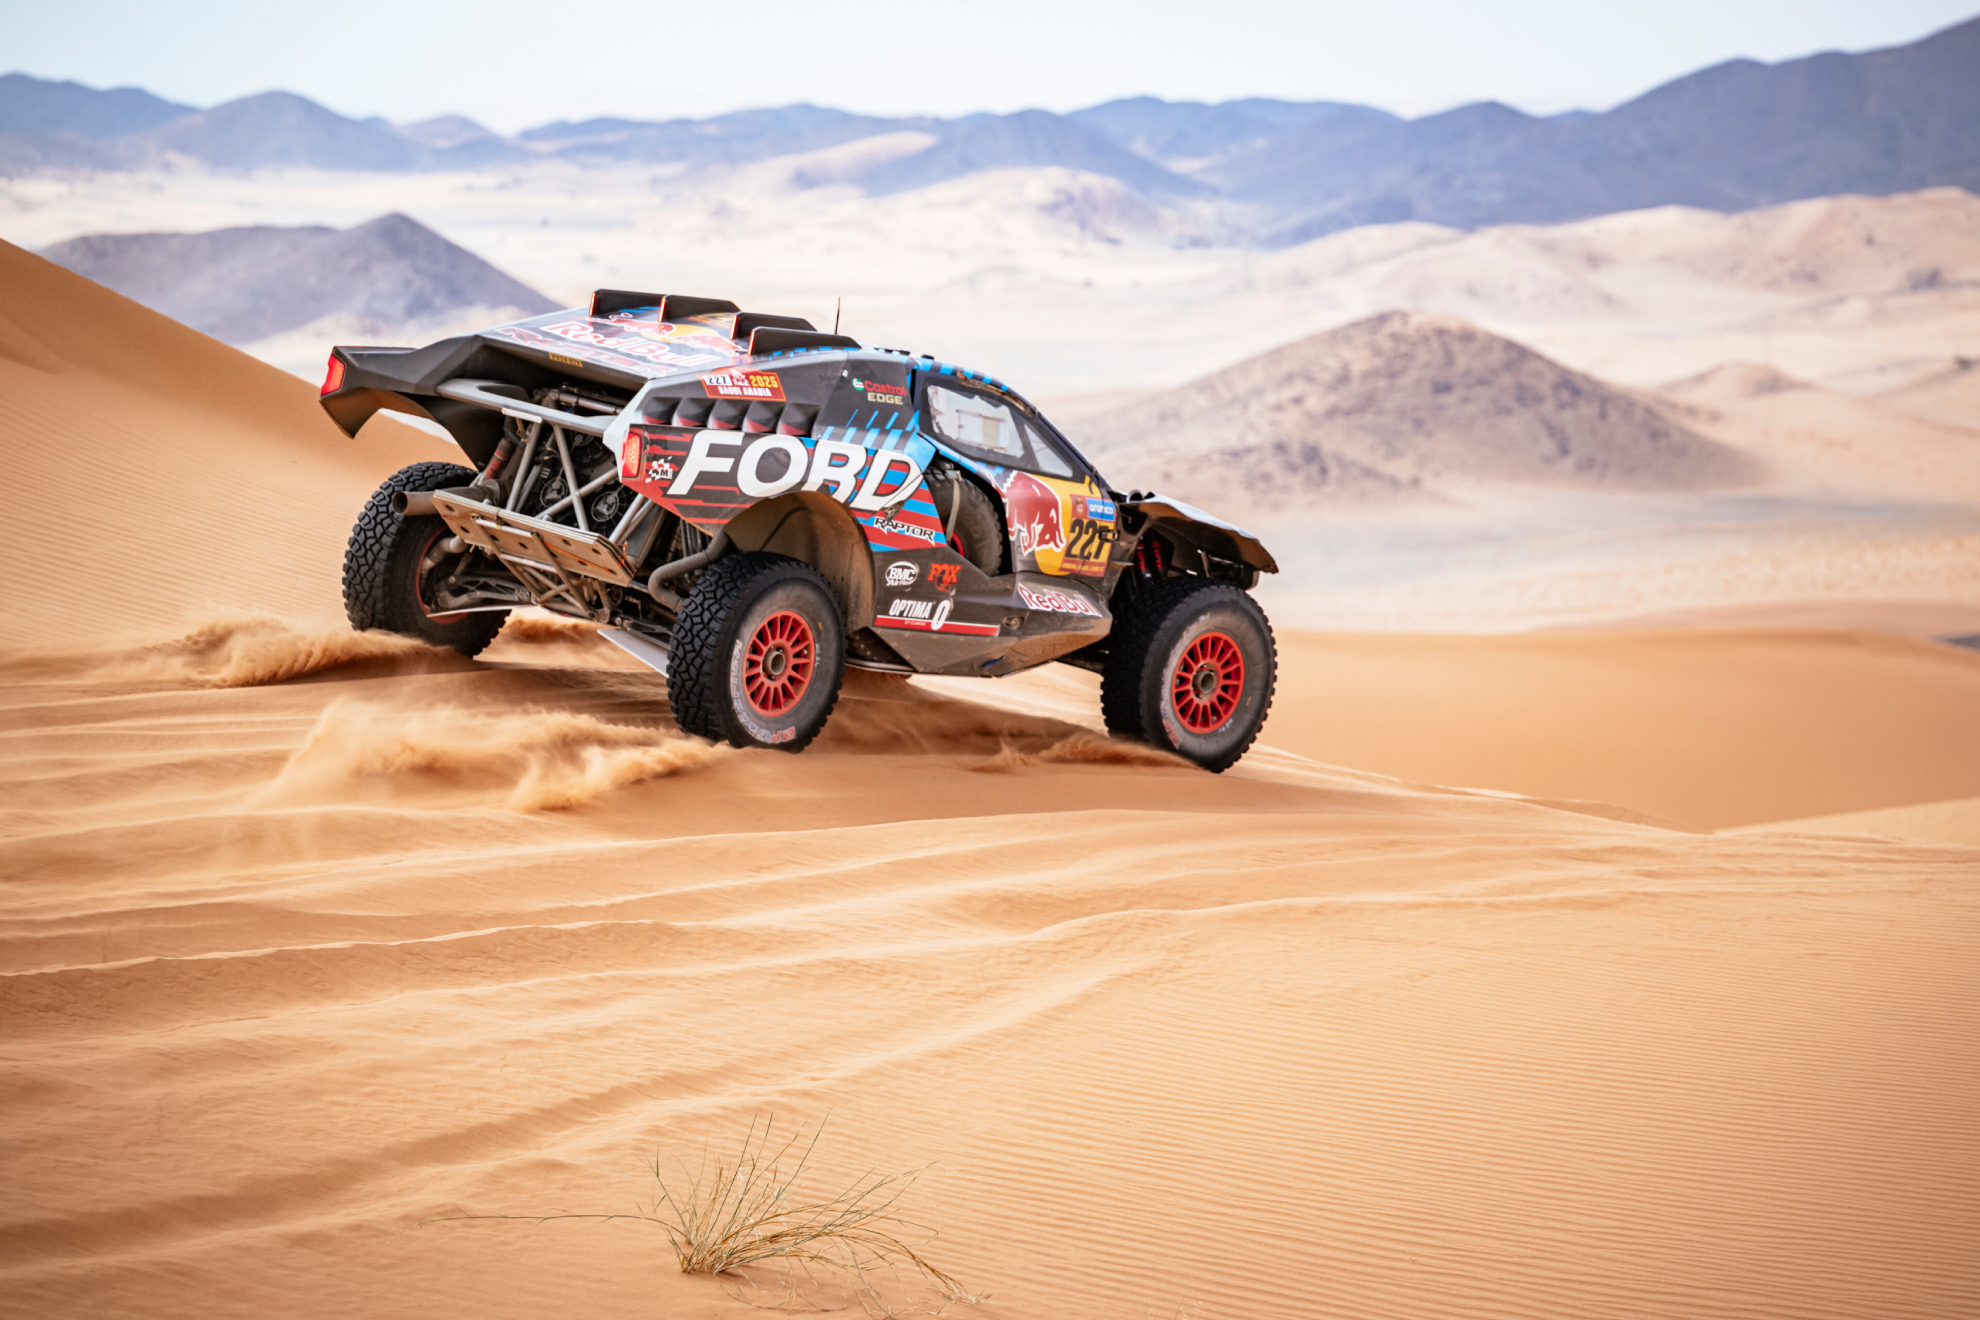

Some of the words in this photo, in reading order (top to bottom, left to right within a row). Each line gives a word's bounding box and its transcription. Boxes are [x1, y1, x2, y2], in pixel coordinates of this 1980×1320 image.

[709, 375, 727, 385] 227
[749, 375, 779, 388] 2025
[864, 380, 907, 396] Castrol
[718, 386, 743, 395] SAUDI
[742, 387, 772, 397] ARABIA
[867, 392, 903, 405] EDGE
[667, 429, 924, 511] FORD
[1089, 504, 1114, 515] aramco
[874, 516, 936, 546] RAPTOR
[889, 567, 916, 581] BMC
[927, 563, 962, 584] FOX
[889, 599, 932, 618] OPTIMA
